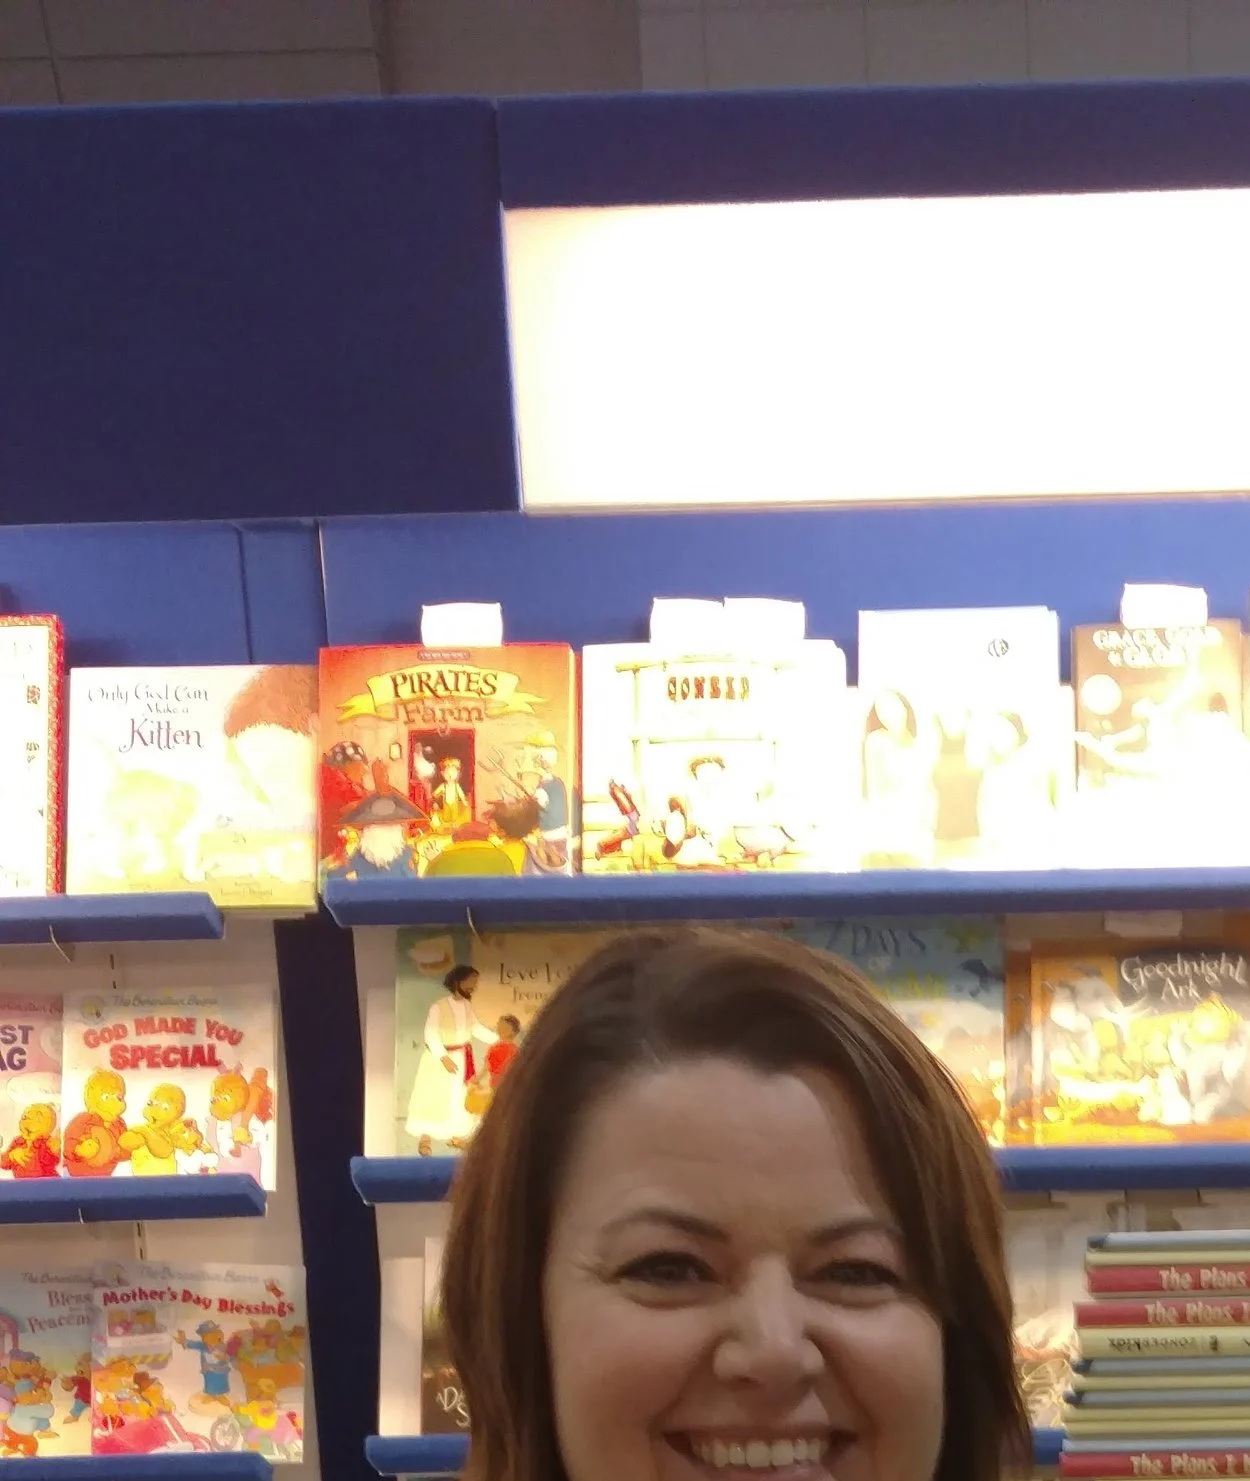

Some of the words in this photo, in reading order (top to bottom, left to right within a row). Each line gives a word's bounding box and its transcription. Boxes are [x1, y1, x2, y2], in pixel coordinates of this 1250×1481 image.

[88, 683, 129, 703] Only
[134, 684, 169, 700] God
[174, 684, 209, 701] Can
[389, 669, 498, 699] PIRATES
[403, 703, 484, 725] Farm
[118, 716, 205, 753] Kitten
[498, 962, 539, 985] Love
[1119, 953, 1250, 986] Goodnight
[1161, 977, 1202, 1002] Ark
[83, 1022, 128, 1049] GOD
[133, 1015, 197, 1037] MADE
[204, 1018, 244, 1046] YOU
[109, 1043, 222, 1071] SPECIAL
[1158, 1264, 1192, 1291] The
[1198, 1263, 1246, 1290] Plans
[102, 1286, 178, 1306] Mother's
[179, 1289, 212, 1311] Day
[216, 1298, 295, 1318] Blessings
[1143, 1298, 1177, 1326] The
[1184, 1297, 1232, 1325] Plans
[1239, 1296, 1250, 1324] I
